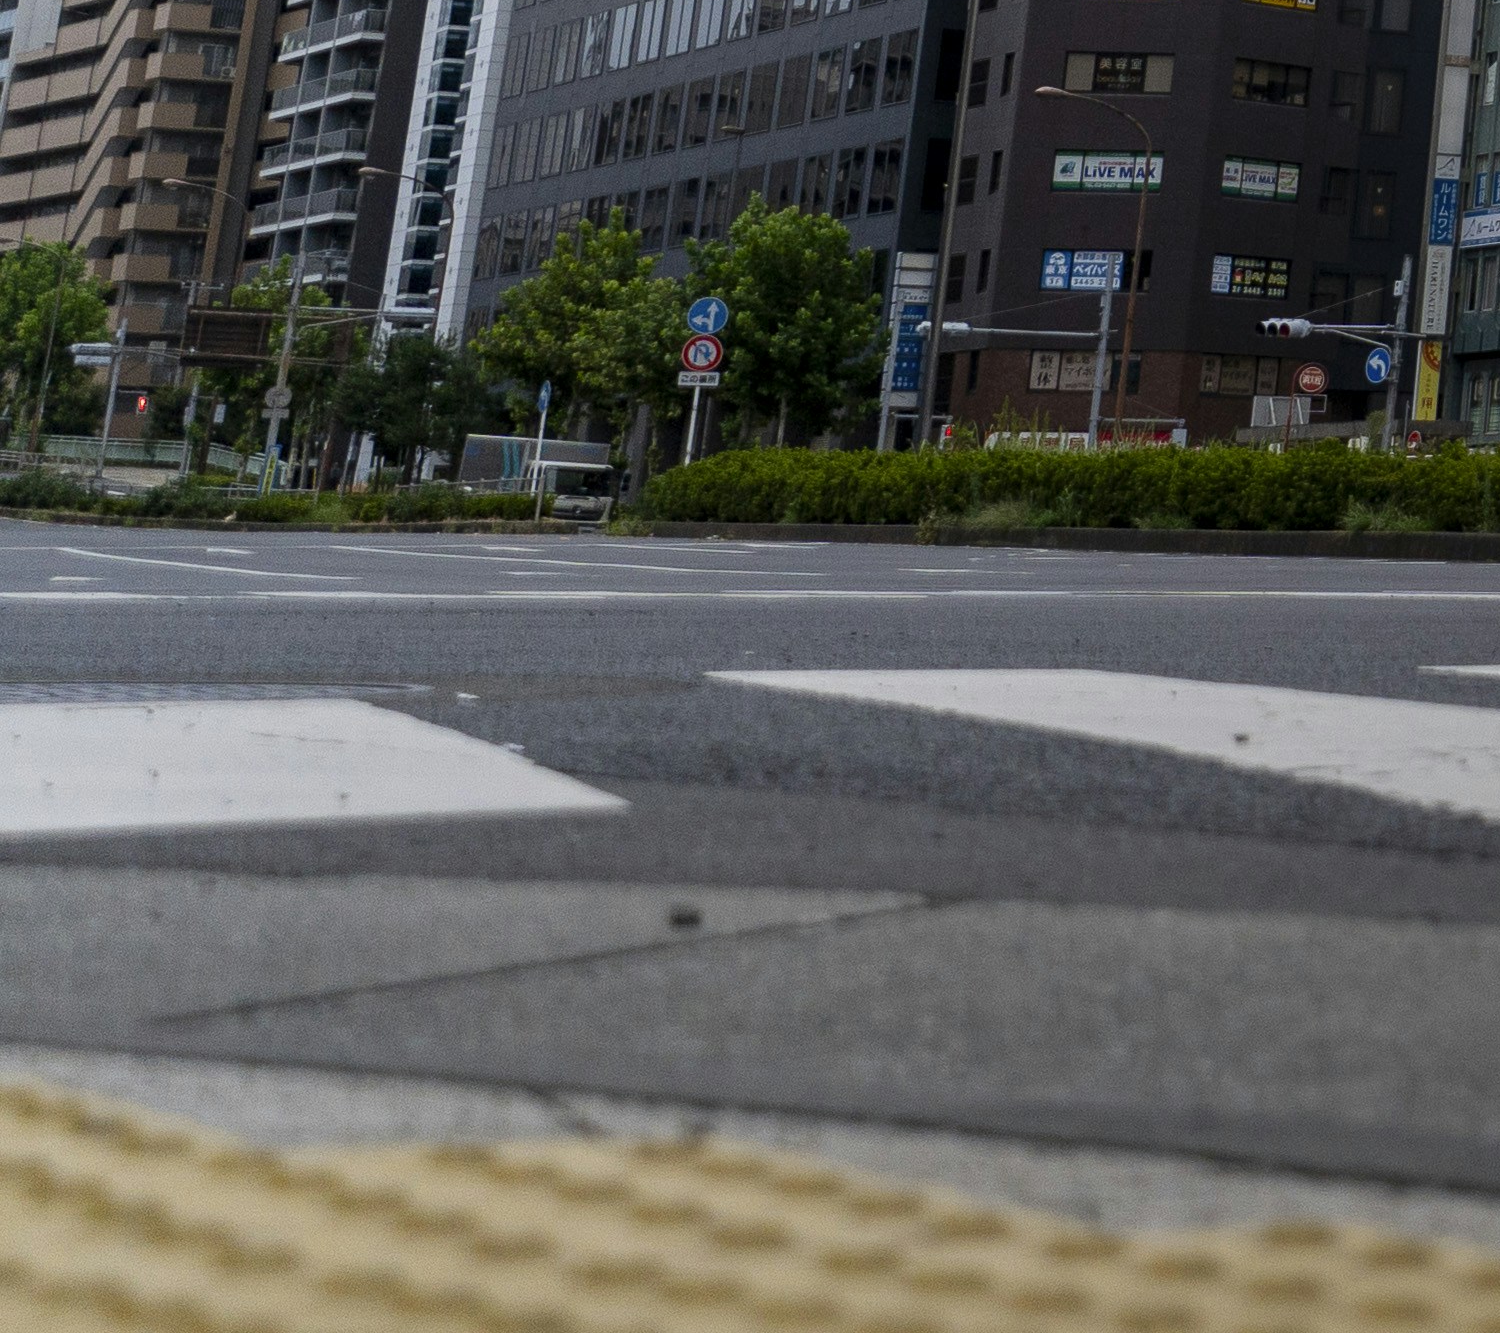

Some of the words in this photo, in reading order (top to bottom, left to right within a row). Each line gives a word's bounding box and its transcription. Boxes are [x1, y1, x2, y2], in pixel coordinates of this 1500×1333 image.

[1100, 56, 1143, 70] 美容室
[1119, 165, 1156, 179] MAX
[1436, 181, 1452, 242] ルームワン
